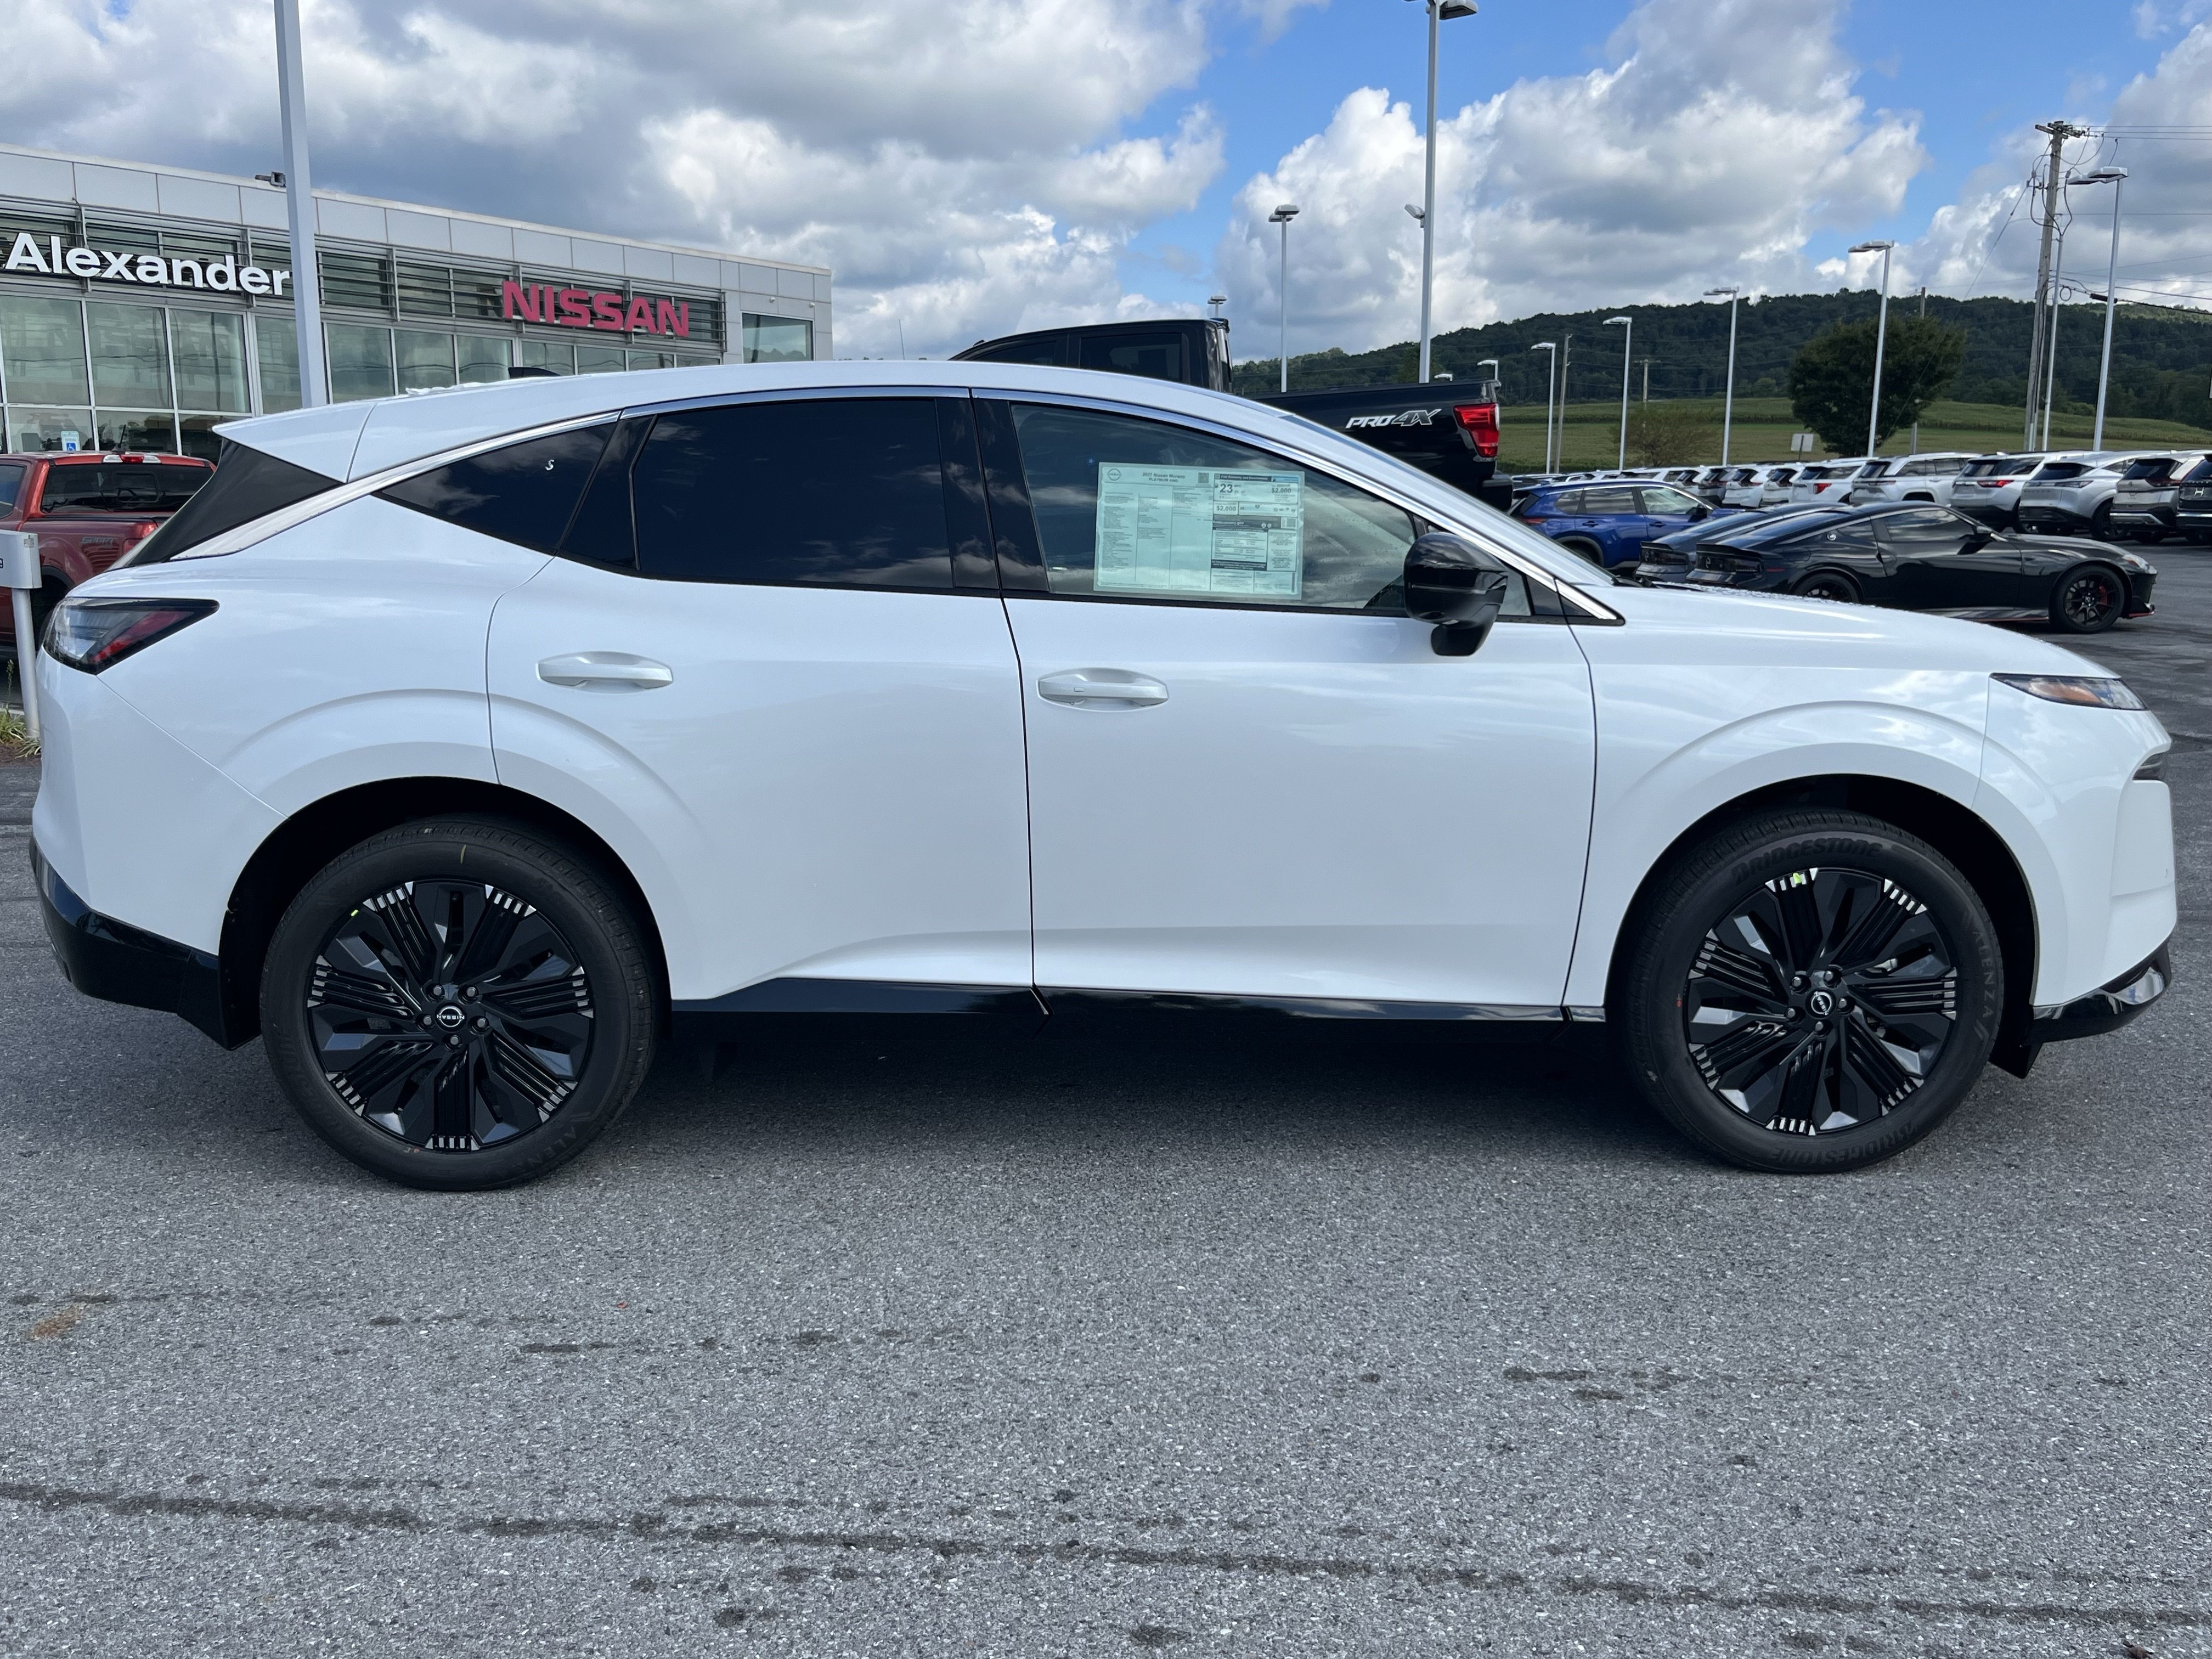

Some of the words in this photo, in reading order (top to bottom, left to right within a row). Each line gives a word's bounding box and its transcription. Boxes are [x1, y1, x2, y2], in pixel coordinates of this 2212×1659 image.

[5, 233, 290, 296] Alexander
[503, 281, 689, 337] NISSAN
[1220, 483, 1233, 493] 23
[1731, 838, 1883, 885] BRIDGESTONE
[1973, 932, 1995, 1018] ALENZA
[1767, 1120, 1917, 1165] BRIDGESTONE
